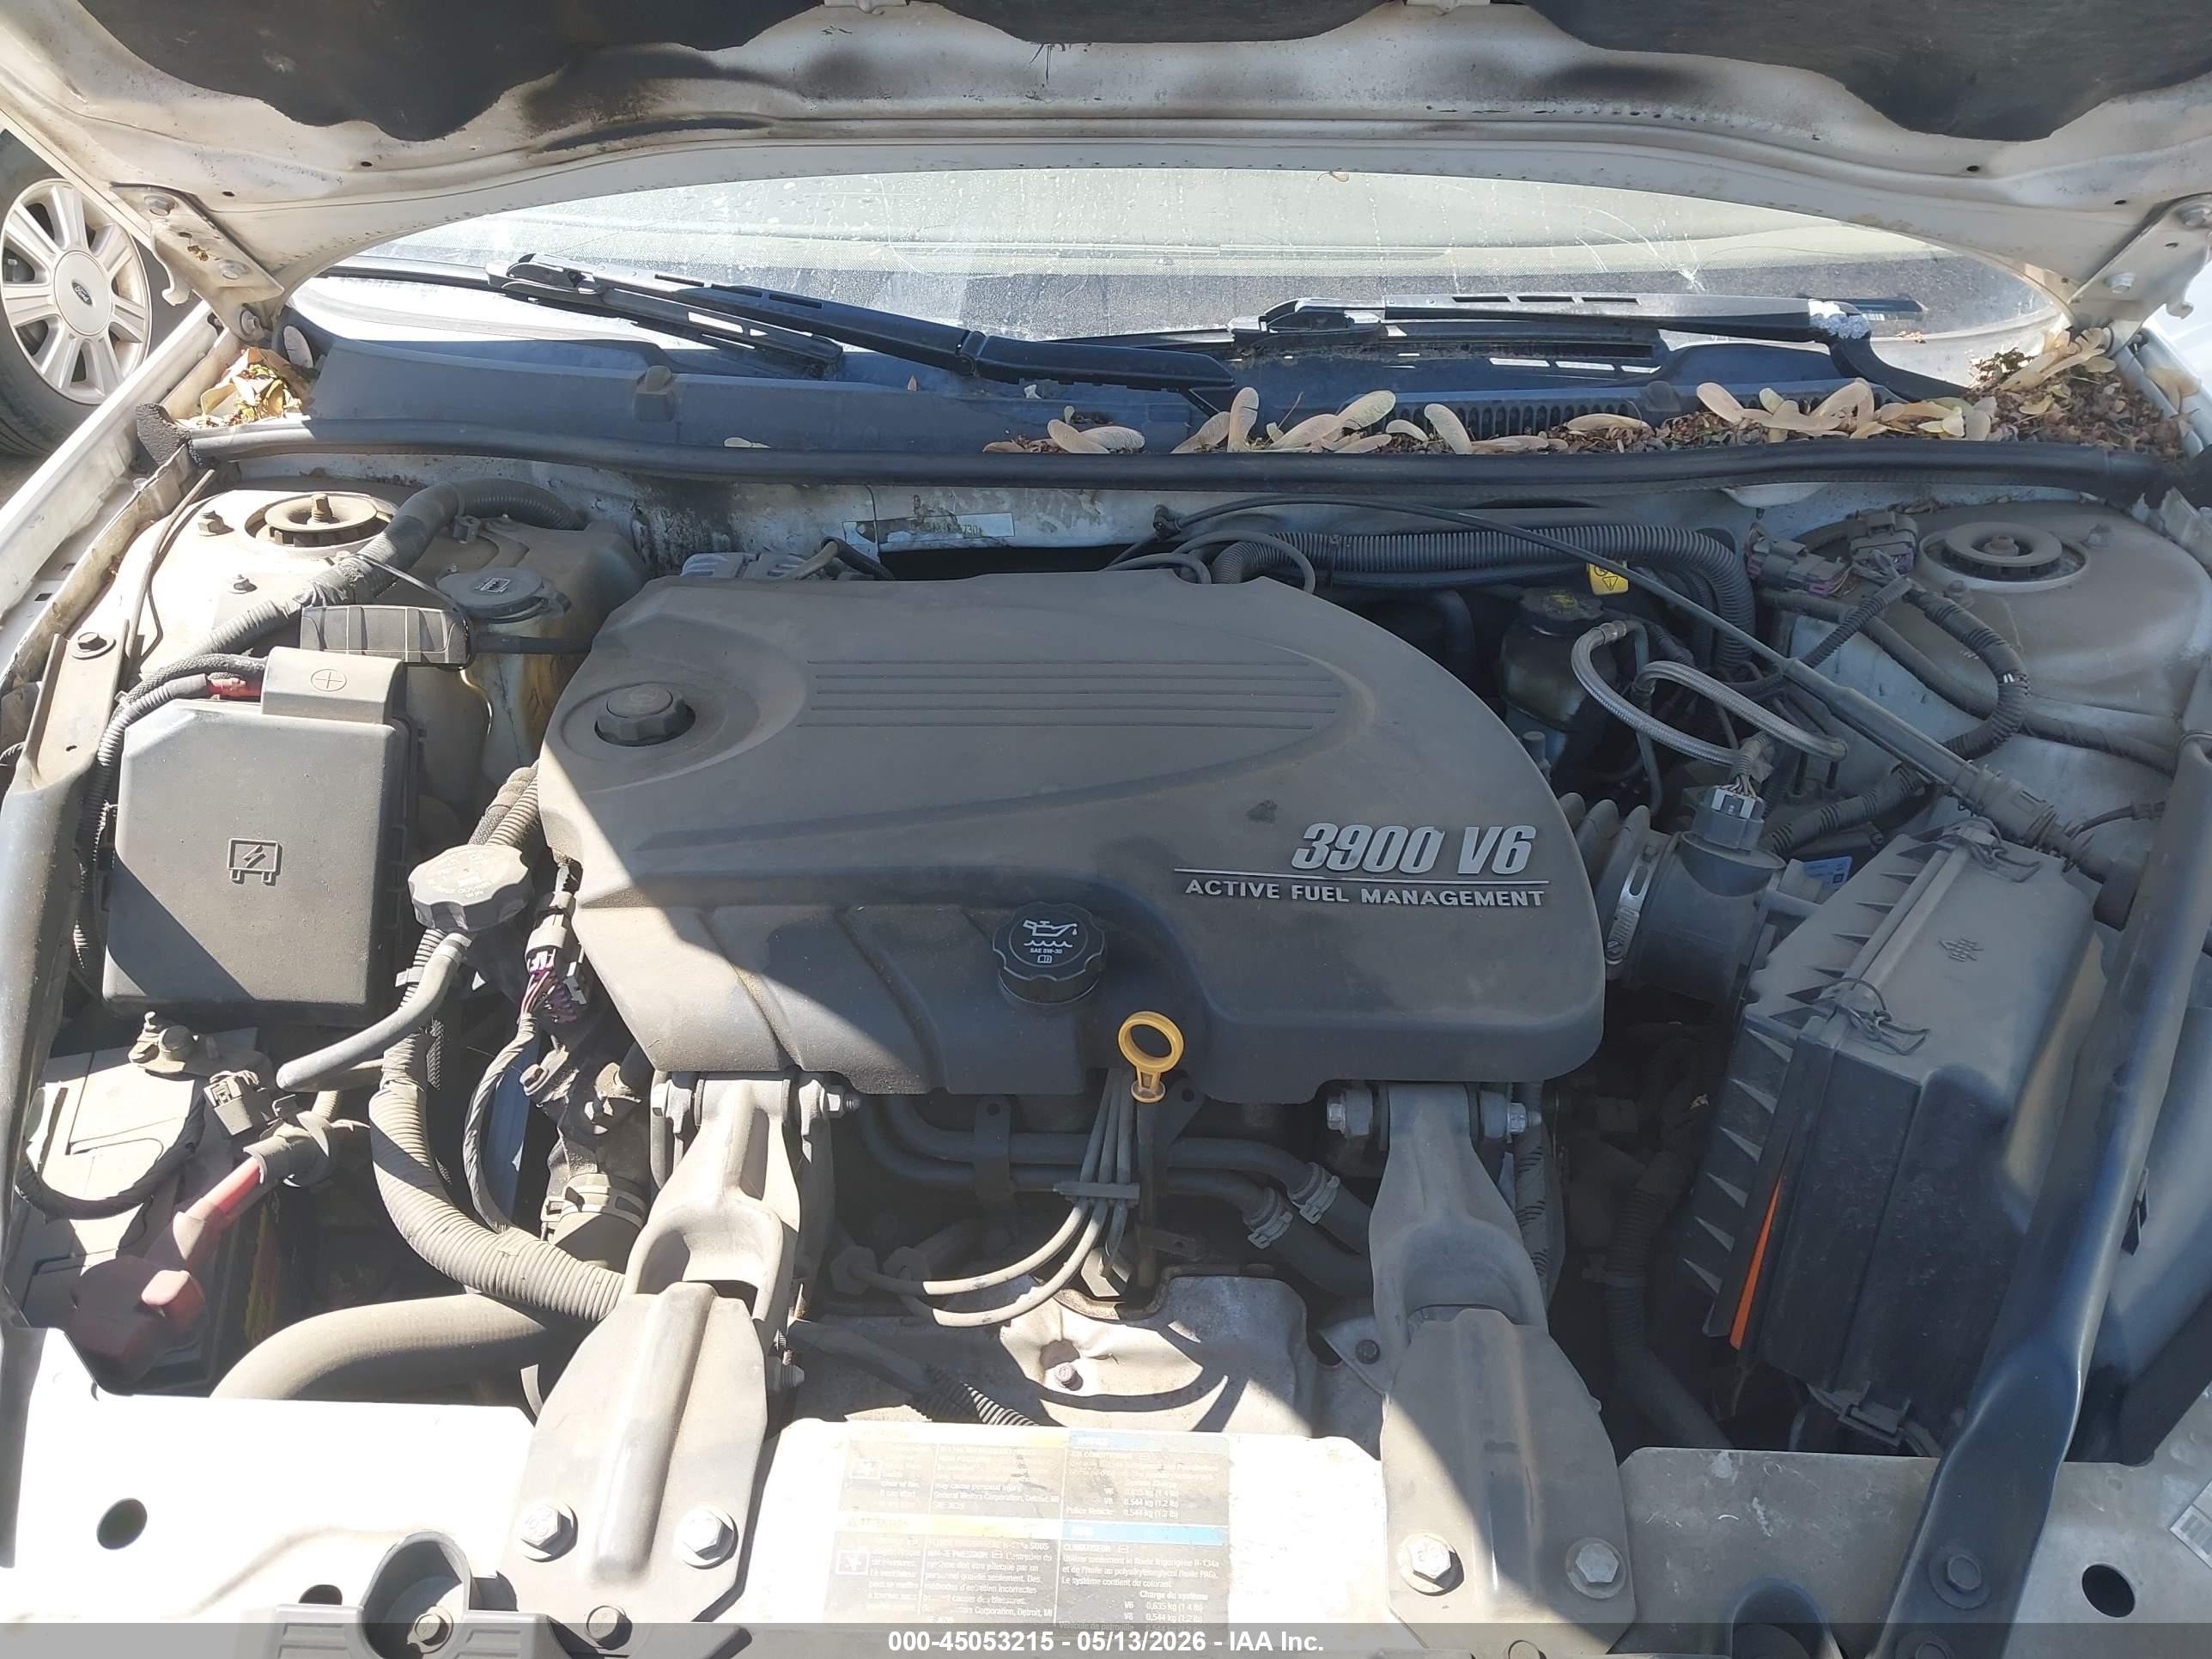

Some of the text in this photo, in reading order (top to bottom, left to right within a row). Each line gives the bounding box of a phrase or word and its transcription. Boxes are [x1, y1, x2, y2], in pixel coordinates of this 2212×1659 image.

[74, 285, 89, 302] Ford
[1291, 823, 1535, 874] 3900 V6
[1185, 878, 1545, 906] ACTIVE FUEL MANAGEMENT
[998, 1585, 1038, 1595] incorrectes
[1125, 1601, 1133, 1609] V6
[1043, 1608, 1053, 1617] MI
